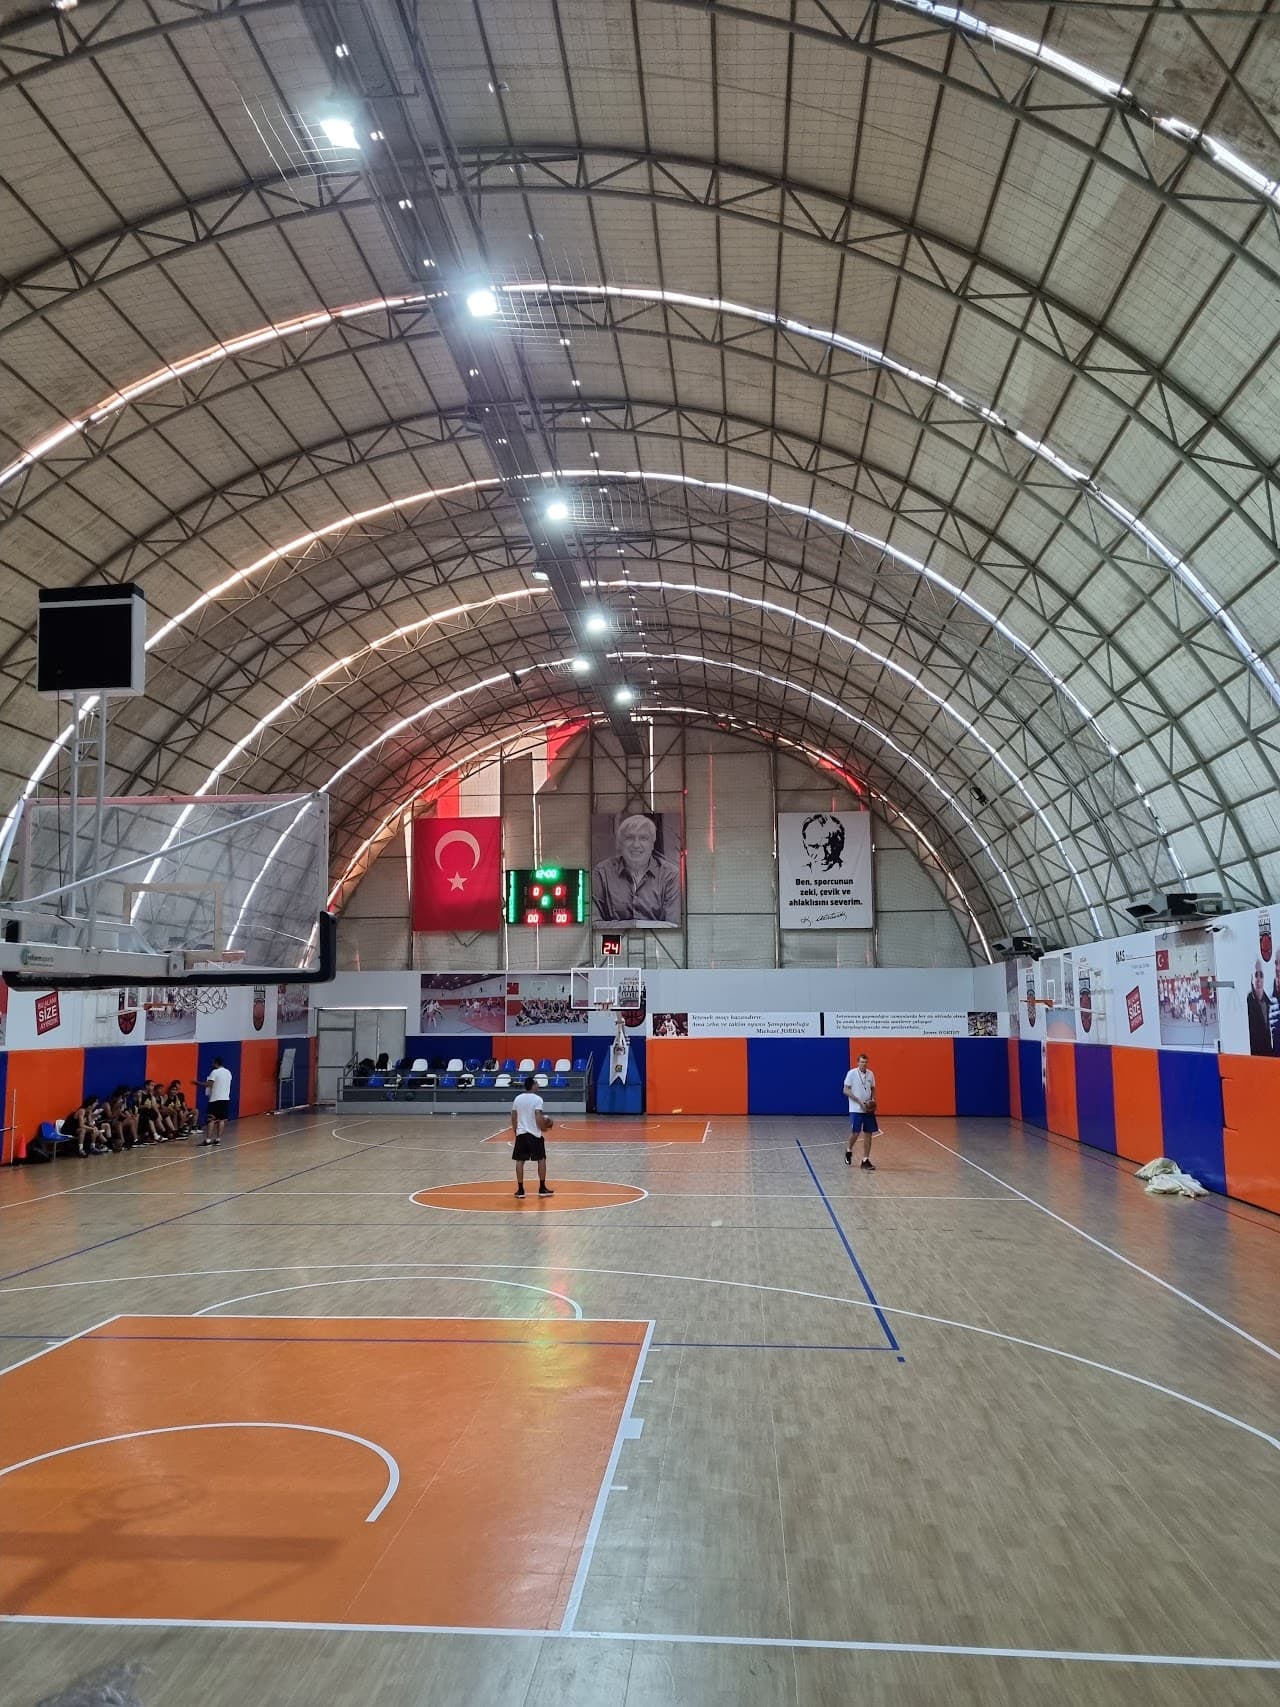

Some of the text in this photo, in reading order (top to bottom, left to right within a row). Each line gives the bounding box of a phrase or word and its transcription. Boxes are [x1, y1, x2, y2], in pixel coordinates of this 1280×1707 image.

[814, 879, 854, 887] sporcunun
[533, 887, 540, 896] 0
[555, 887, 562, 896] 0
[800, 888, 818, 896] zeki,
[819, 888, 840, 897] çevik
[830, 898, 863, 906] severim.
[527, 913, 539, 923] 00
[555, 913, 568, 923] 00
[603, 942, 619, 955] 24
